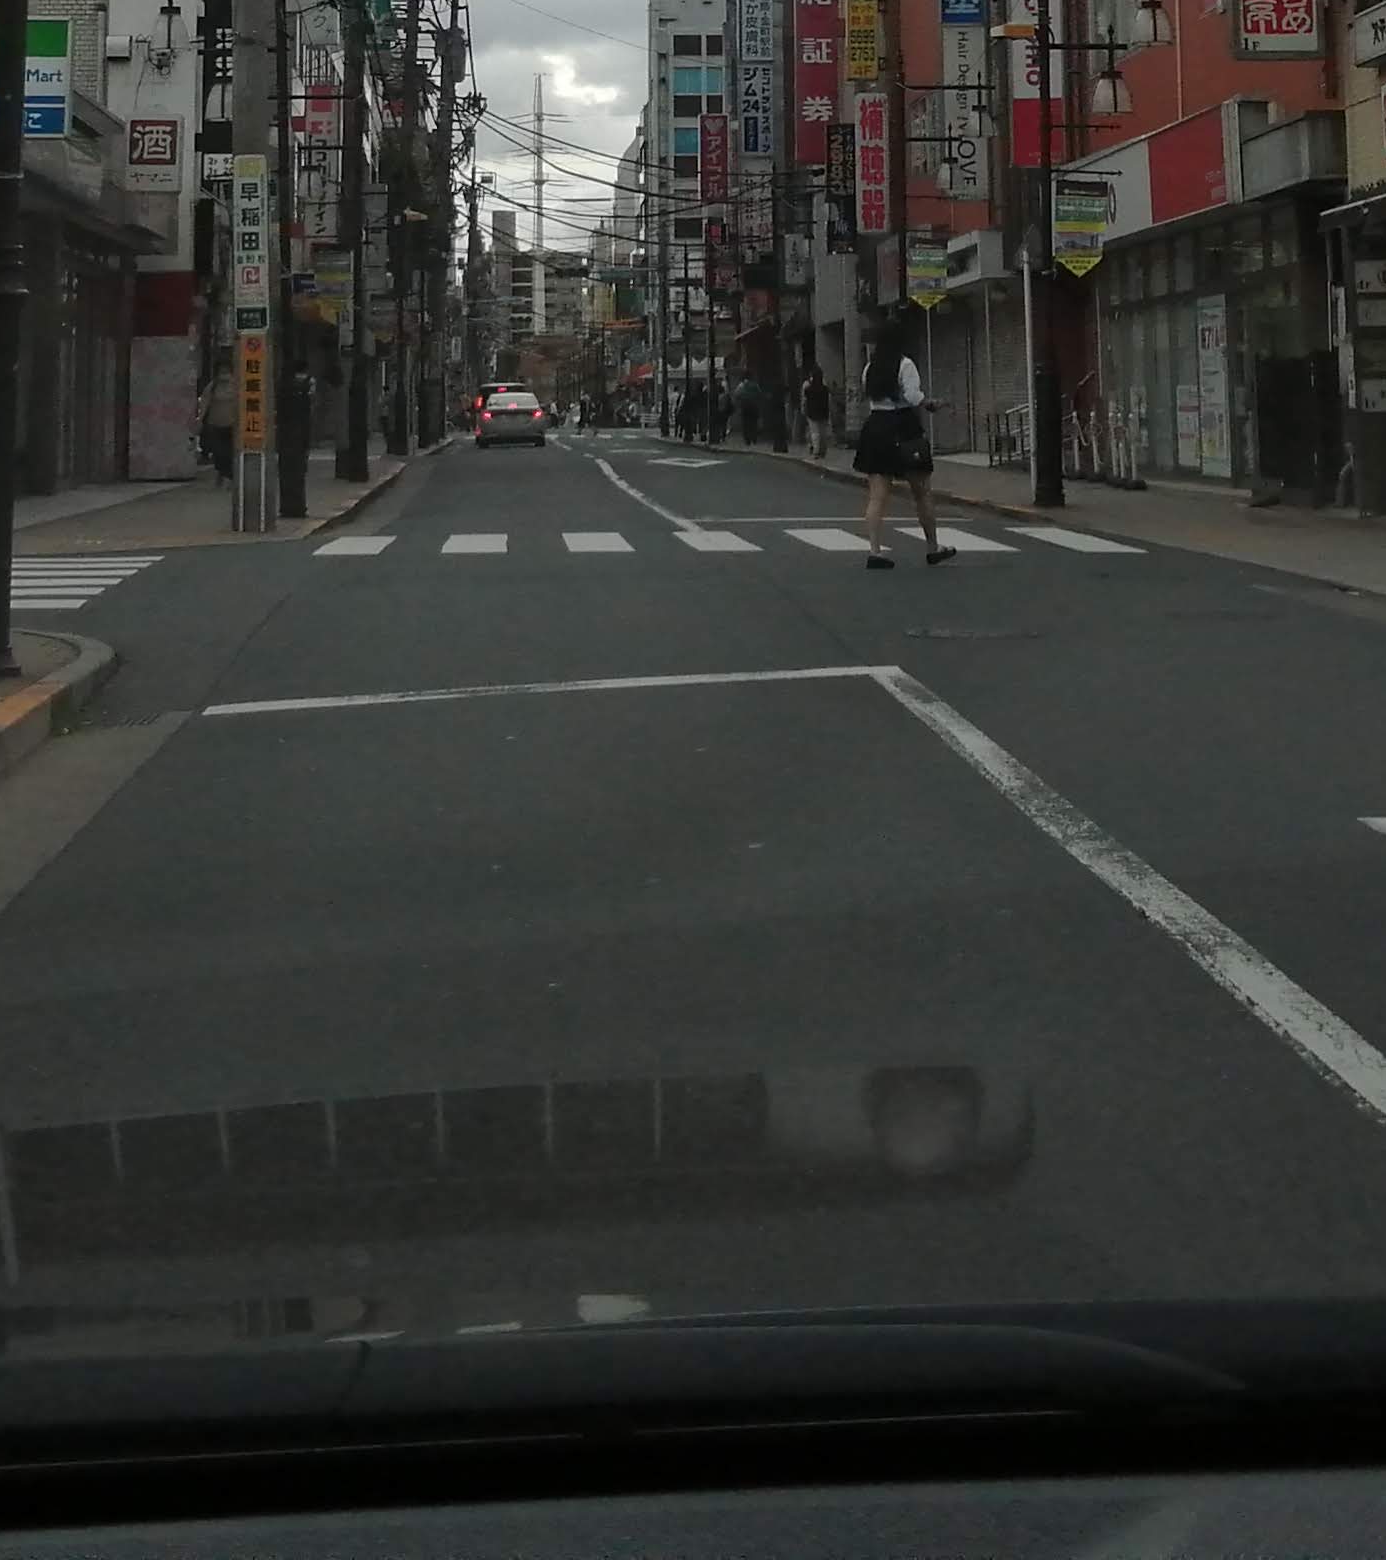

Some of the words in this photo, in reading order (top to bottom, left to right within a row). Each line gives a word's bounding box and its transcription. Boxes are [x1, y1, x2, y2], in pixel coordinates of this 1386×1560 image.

[133, 125, 173, 160] 酒
[860, 98, 886, 230] 補聴器
[240, 183, 260, 251] 早稲田
